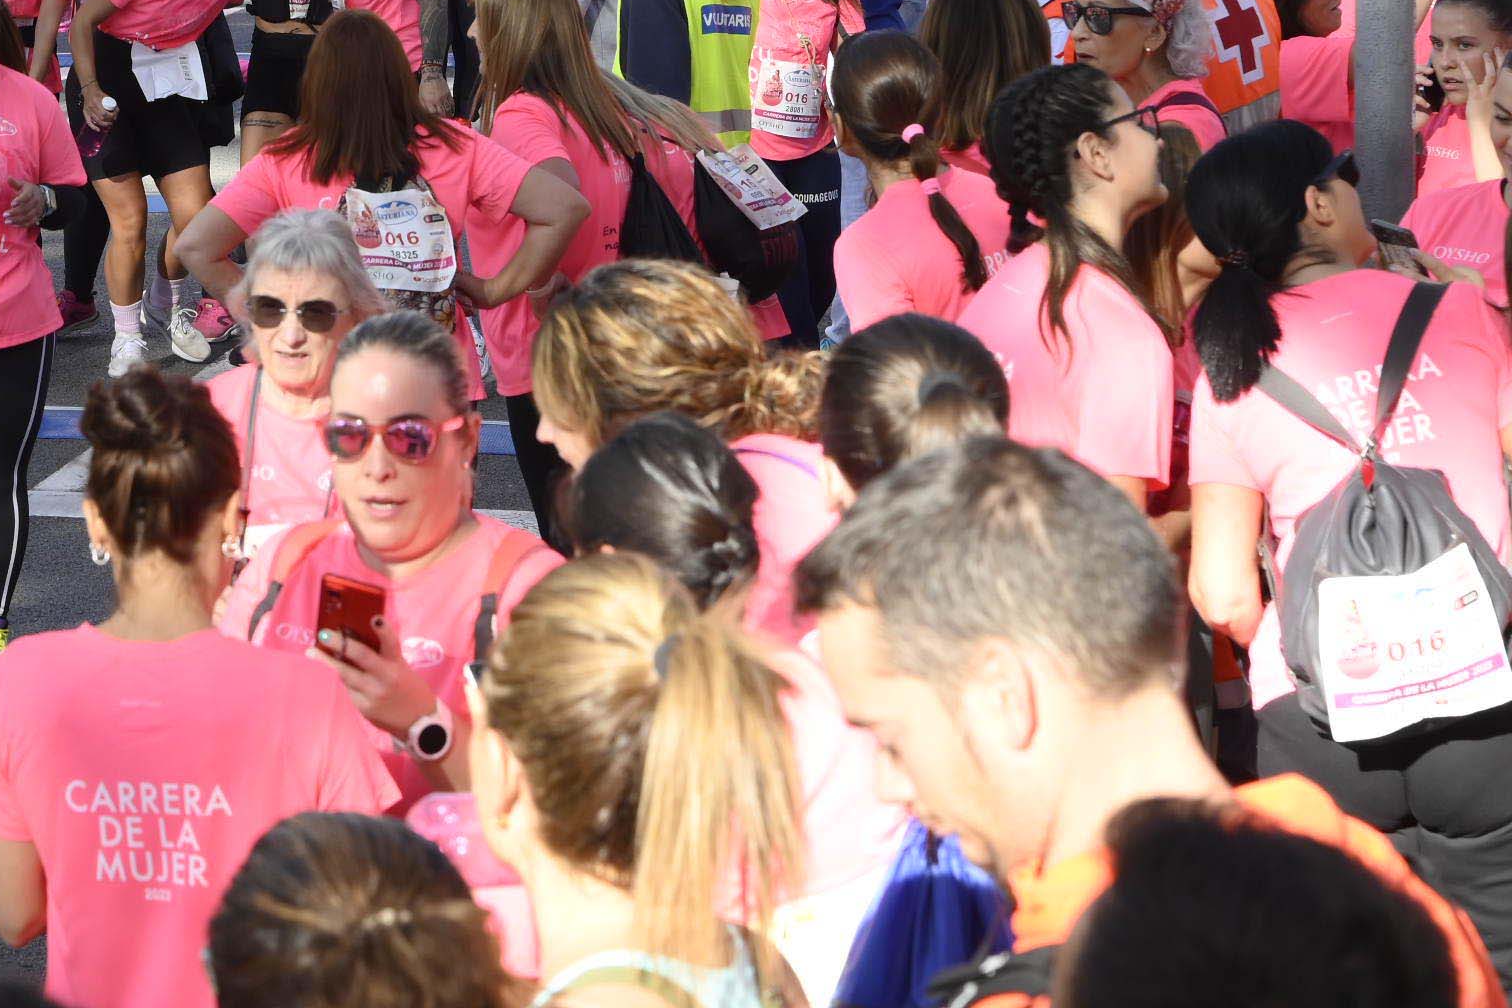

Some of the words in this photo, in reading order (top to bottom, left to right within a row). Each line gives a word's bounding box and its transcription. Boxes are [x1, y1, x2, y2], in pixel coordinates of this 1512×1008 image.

[784, 92, 808, 104] 016
[762, 111, 786, 120] CARRERA
[785, 105, 804, 114] 28081
[384, 231, 420, 246] 016
[362, 256, 394, 266] CARRERA
[1432, 245, 1490, 265] OYSHO
[274, 622, 315, 644] OYS
[1386, 630, 1446, 663] 016
[65, 779, 233, 817] CARRERA
[98, 816, 143, 849] DE
[158, 816, 200, 852] LA
[96, 850, 209, 889] MUJER
